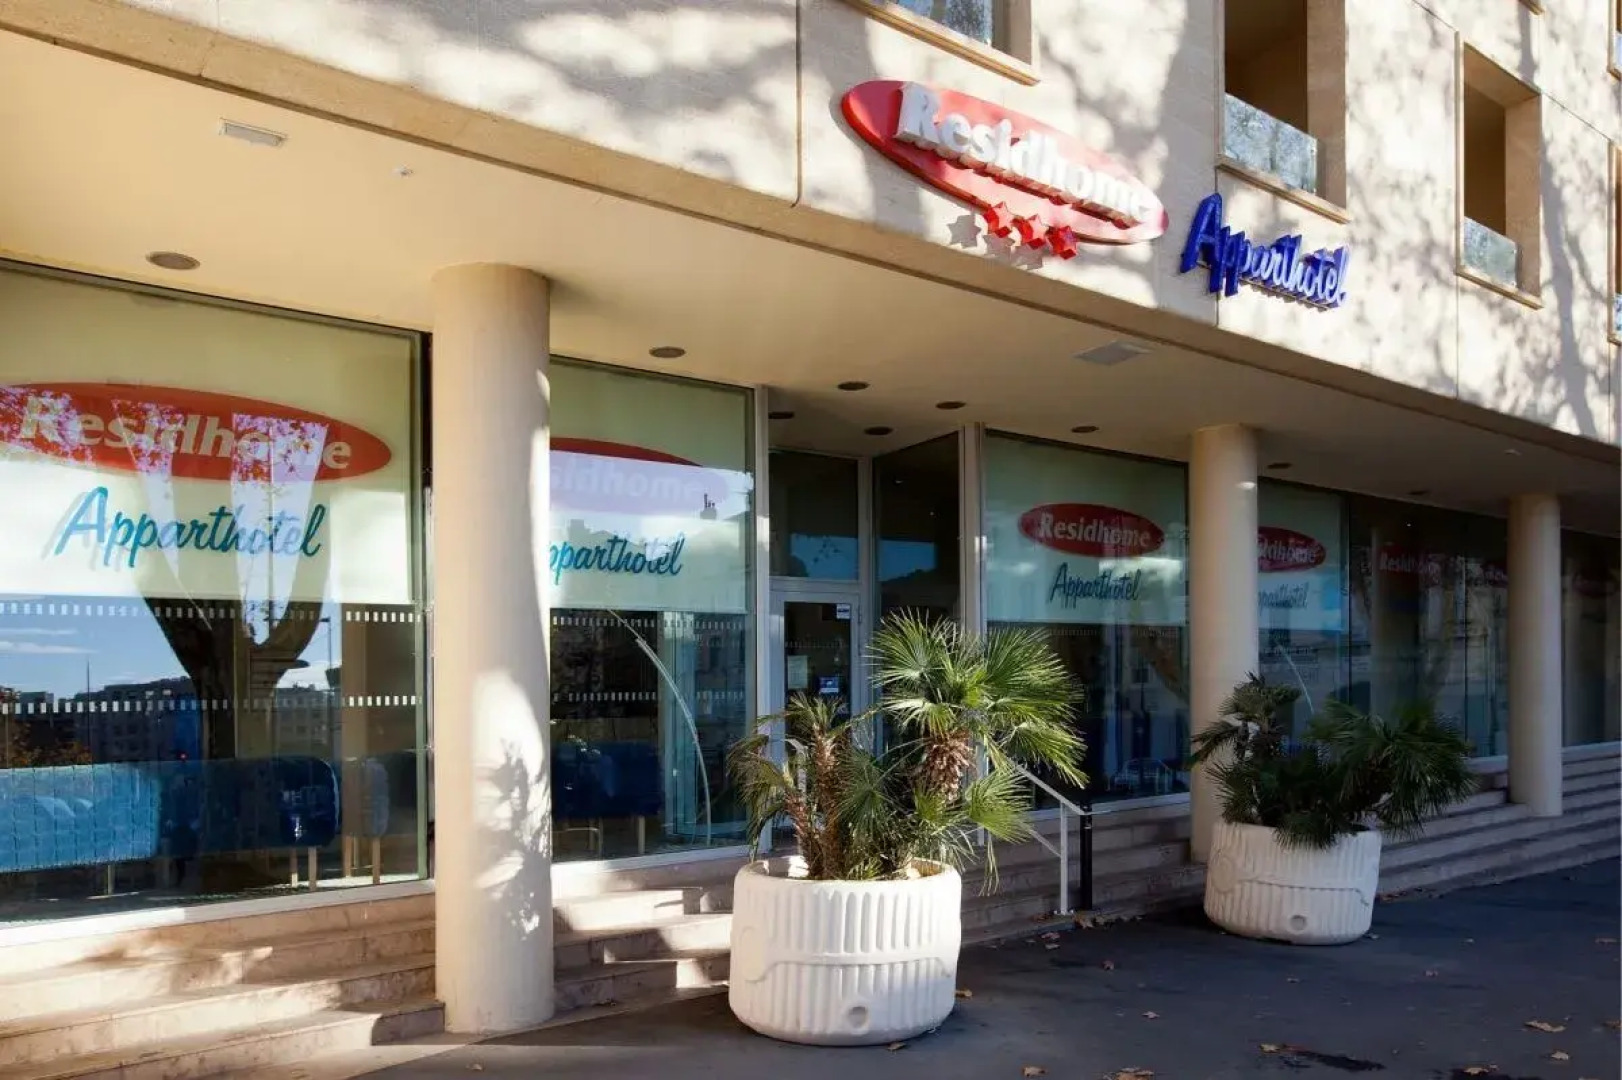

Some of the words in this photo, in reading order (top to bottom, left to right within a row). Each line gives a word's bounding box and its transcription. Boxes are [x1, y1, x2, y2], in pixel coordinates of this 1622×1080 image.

[896, 80, 1152, 230] Residhome
[1180, 193, 1349, 310] Apparthotel
[20, 395, 352, 470] Residhoe
[54, 486, 326, 568] Apparthotel
[1038, 511, 1152, 548] Residhome
[1050, 561, 1142, 610] Apparthotel
